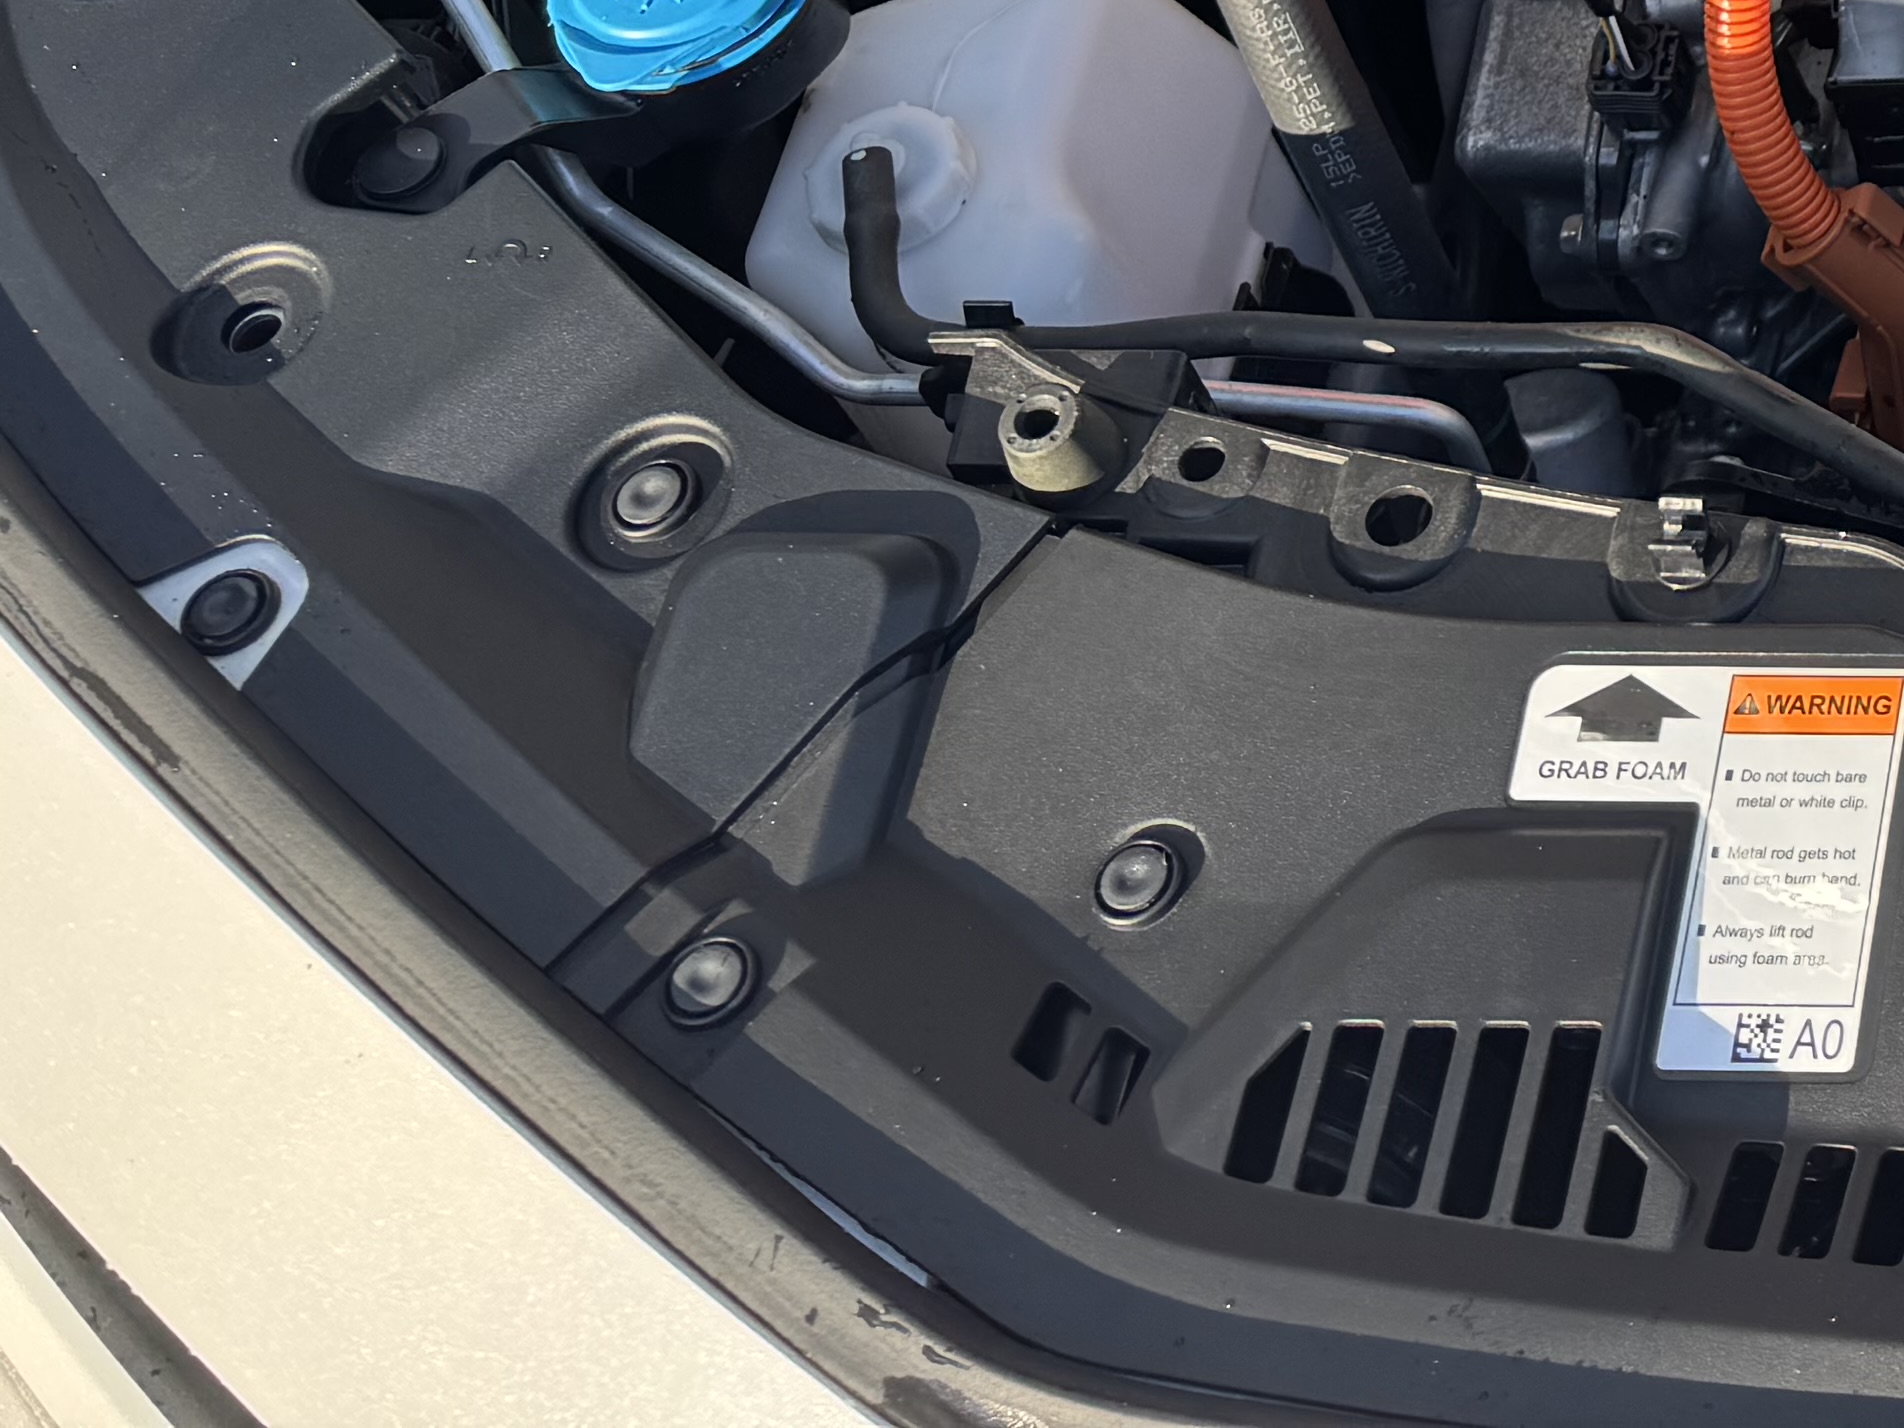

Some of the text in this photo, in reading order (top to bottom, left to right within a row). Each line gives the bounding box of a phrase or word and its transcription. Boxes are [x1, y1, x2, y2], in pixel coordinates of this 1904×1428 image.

[1766, 694, 1892, 716] WARNING
[1538, 760, 1687, 781] GRAB FOAM
[1741, 769, 1867, 784] Do not touch bare
[1736, 795, 1868, 811] metal or white clip.
[1727, 846, 1856, 863] Metal rod gets hot
[1722, 872, 1750, 886] and
[1713, 924, 1813, 940] Always lift rod
[1708, 952, 1747, 968] using
[1752, 952, 1788, 966] foam
[1789, 1018, 1845, 1060] A0
